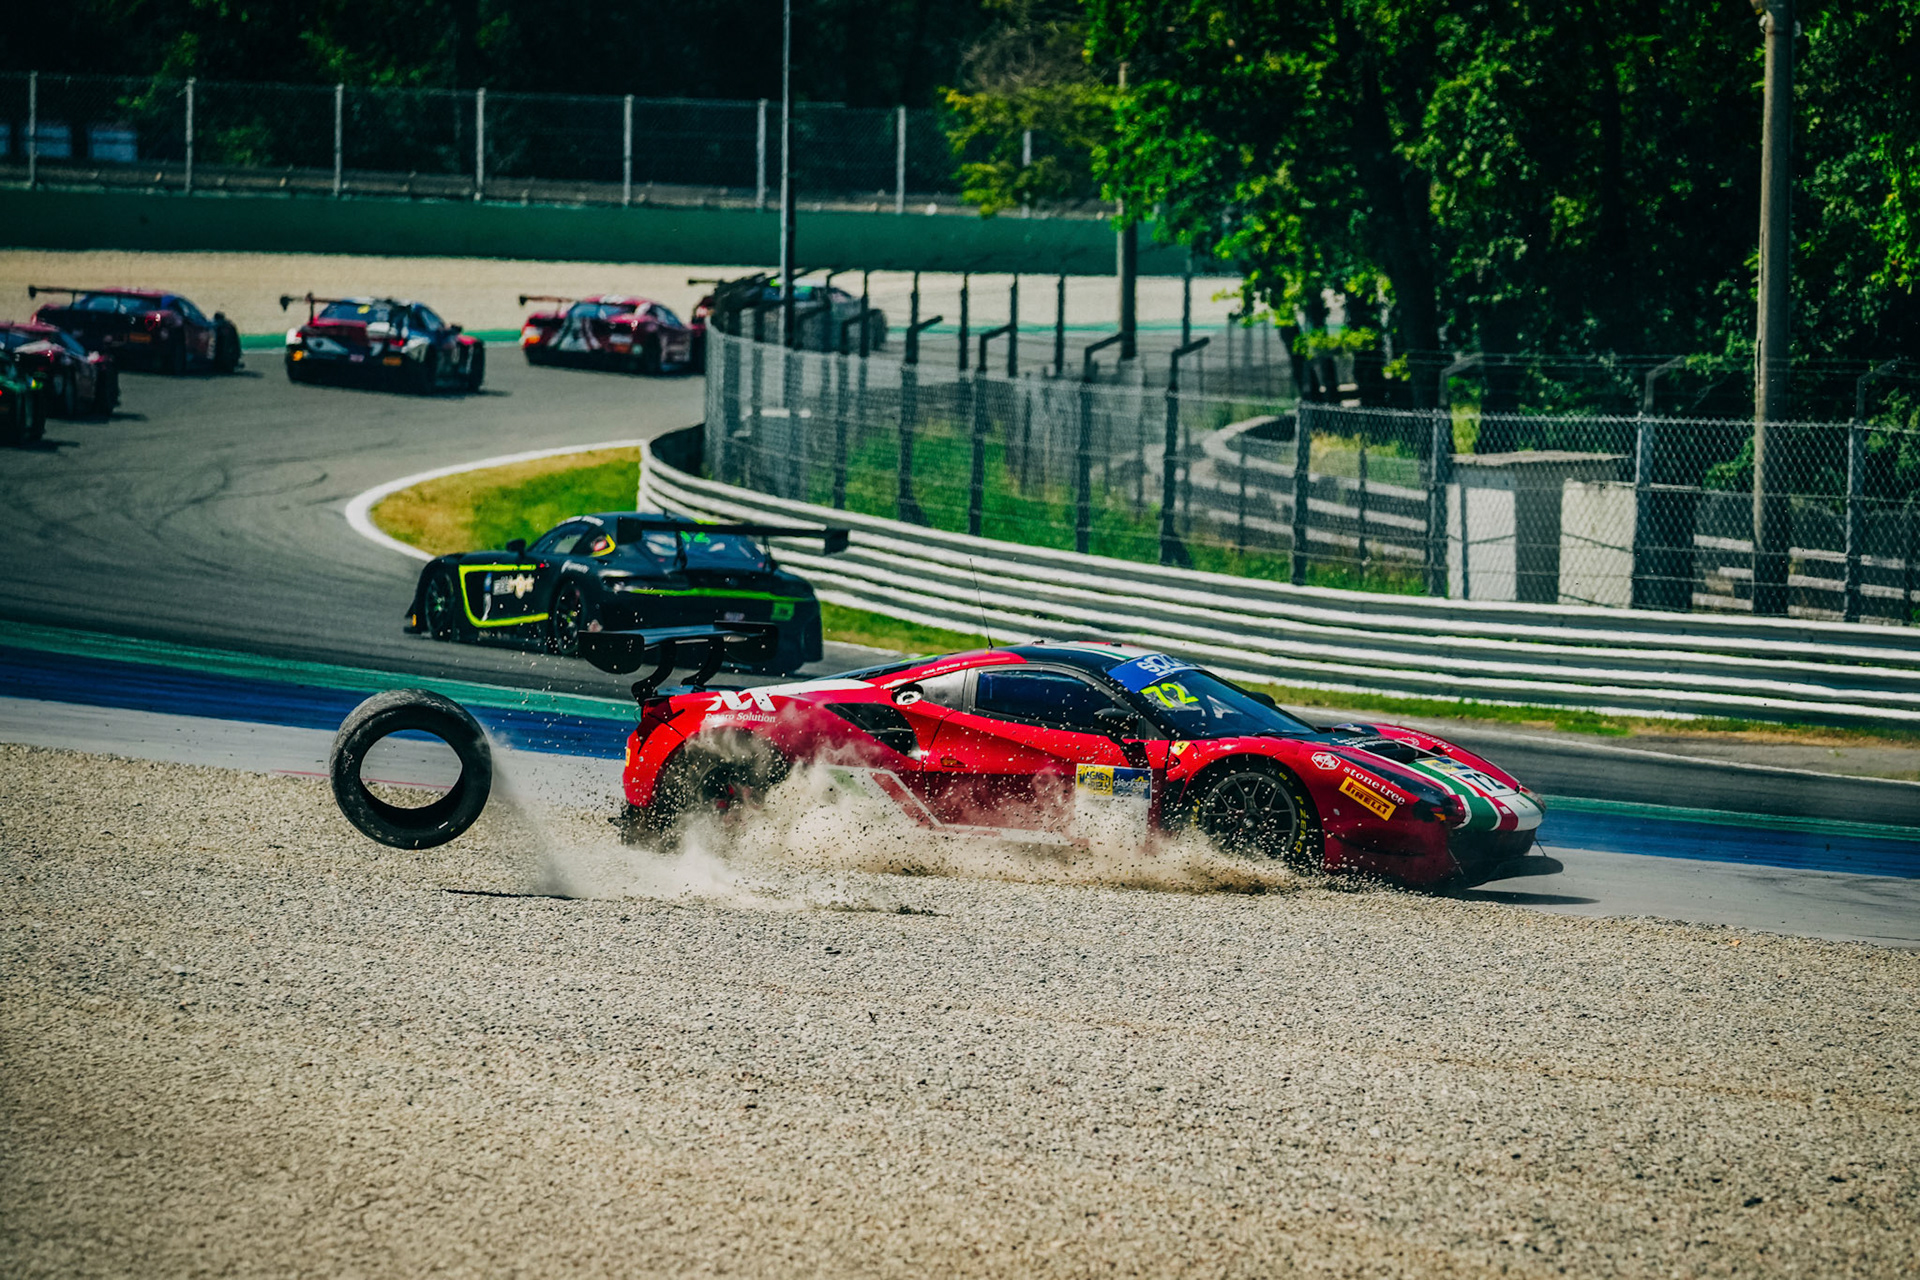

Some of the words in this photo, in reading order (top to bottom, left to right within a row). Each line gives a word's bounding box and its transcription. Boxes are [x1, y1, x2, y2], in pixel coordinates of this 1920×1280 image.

[1140, 683, 1199, 708] 72
[736, 713, 776, 723] Solution
[1343, 766, 1406, 806] stonetree
[1461, 772, 1507, 792] 72
[1345, 781, 1390, 815] PIRELLI
